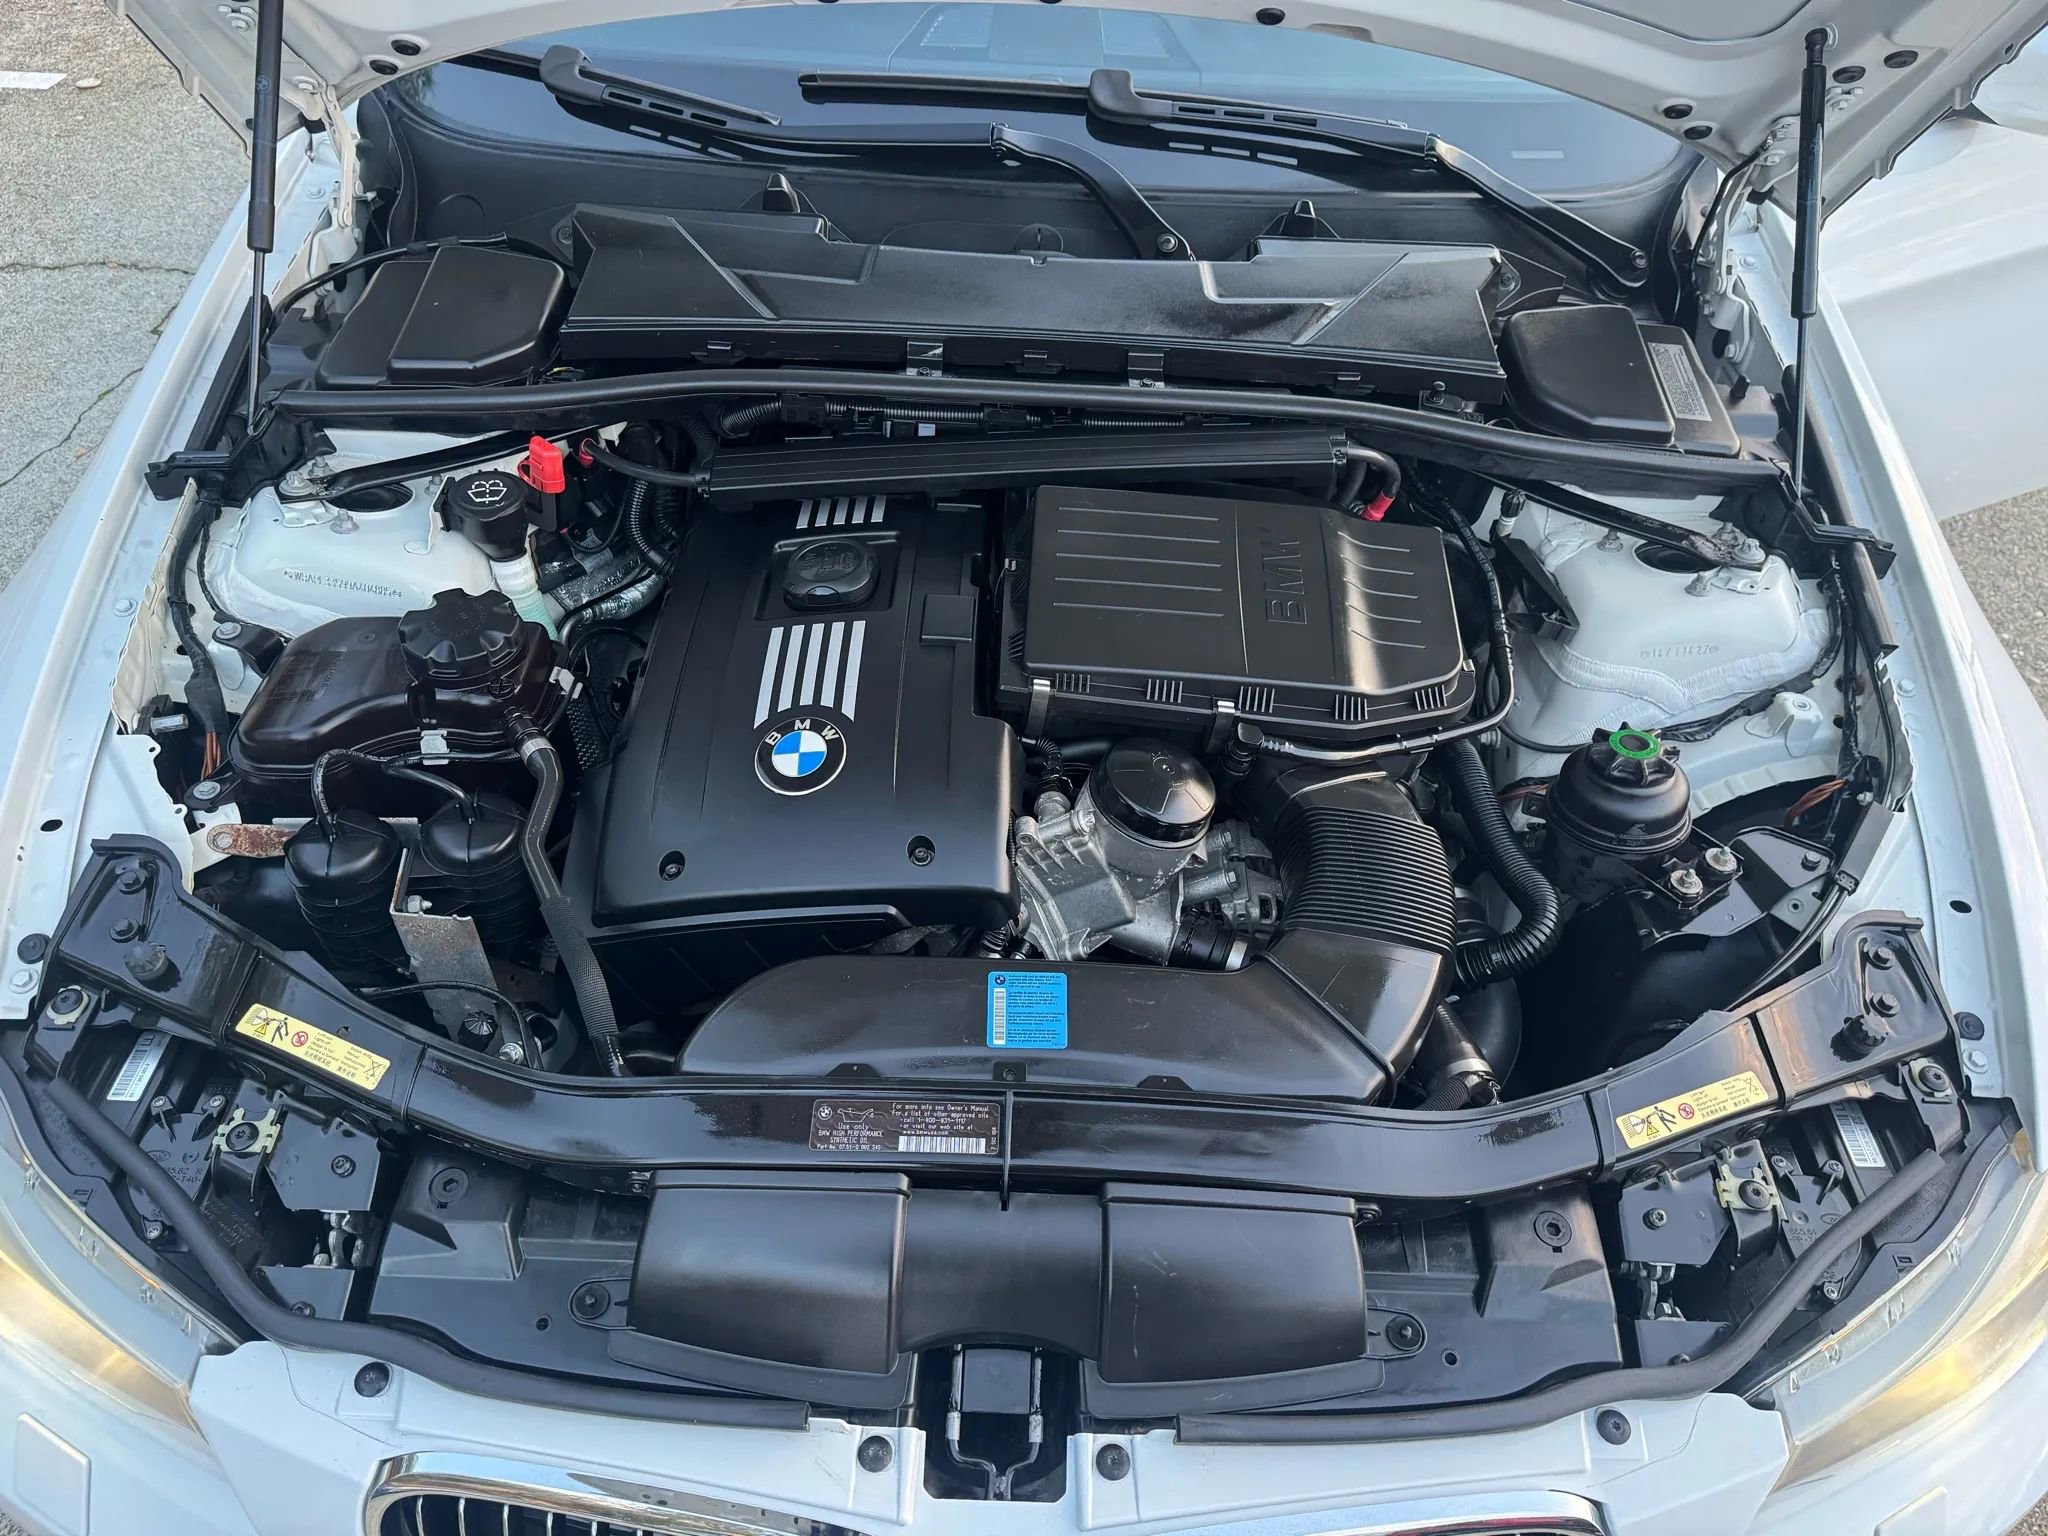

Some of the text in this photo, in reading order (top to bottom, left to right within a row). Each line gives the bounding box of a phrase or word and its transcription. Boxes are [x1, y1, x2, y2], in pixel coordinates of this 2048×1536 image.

[1262, 528, 1307, 625] BMW
[764, 718, 840, 746] BMW
[838, 1122, 870, 1131] Use only
